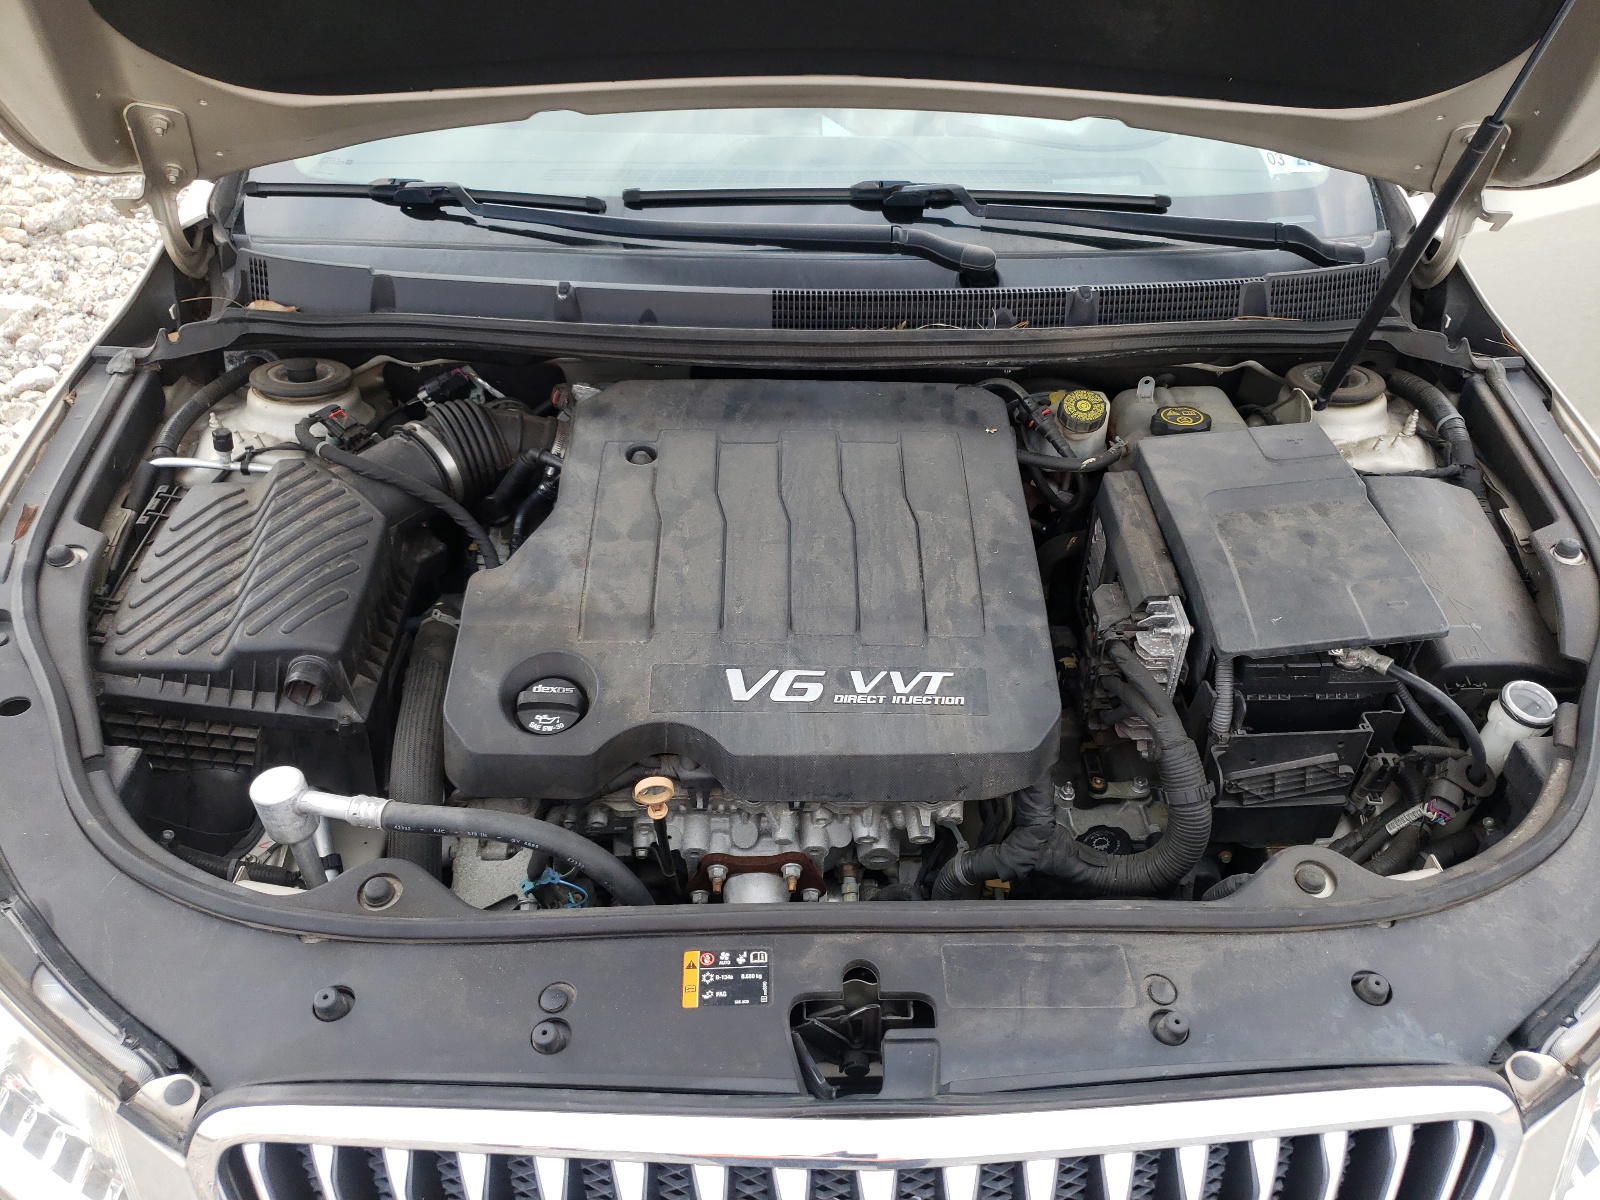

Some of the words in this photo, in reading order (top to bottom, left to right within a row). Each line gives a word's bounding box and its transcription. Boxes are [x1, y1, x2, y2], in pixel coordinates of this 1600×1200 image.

[532, 684, 576, 694] dexos
[725, 668, 827, 702] V6
[850, 670, 955, 695] VVT
[833, 694, 887, 705] DIRECT
[891, 695, 965, 706] INJECTION
